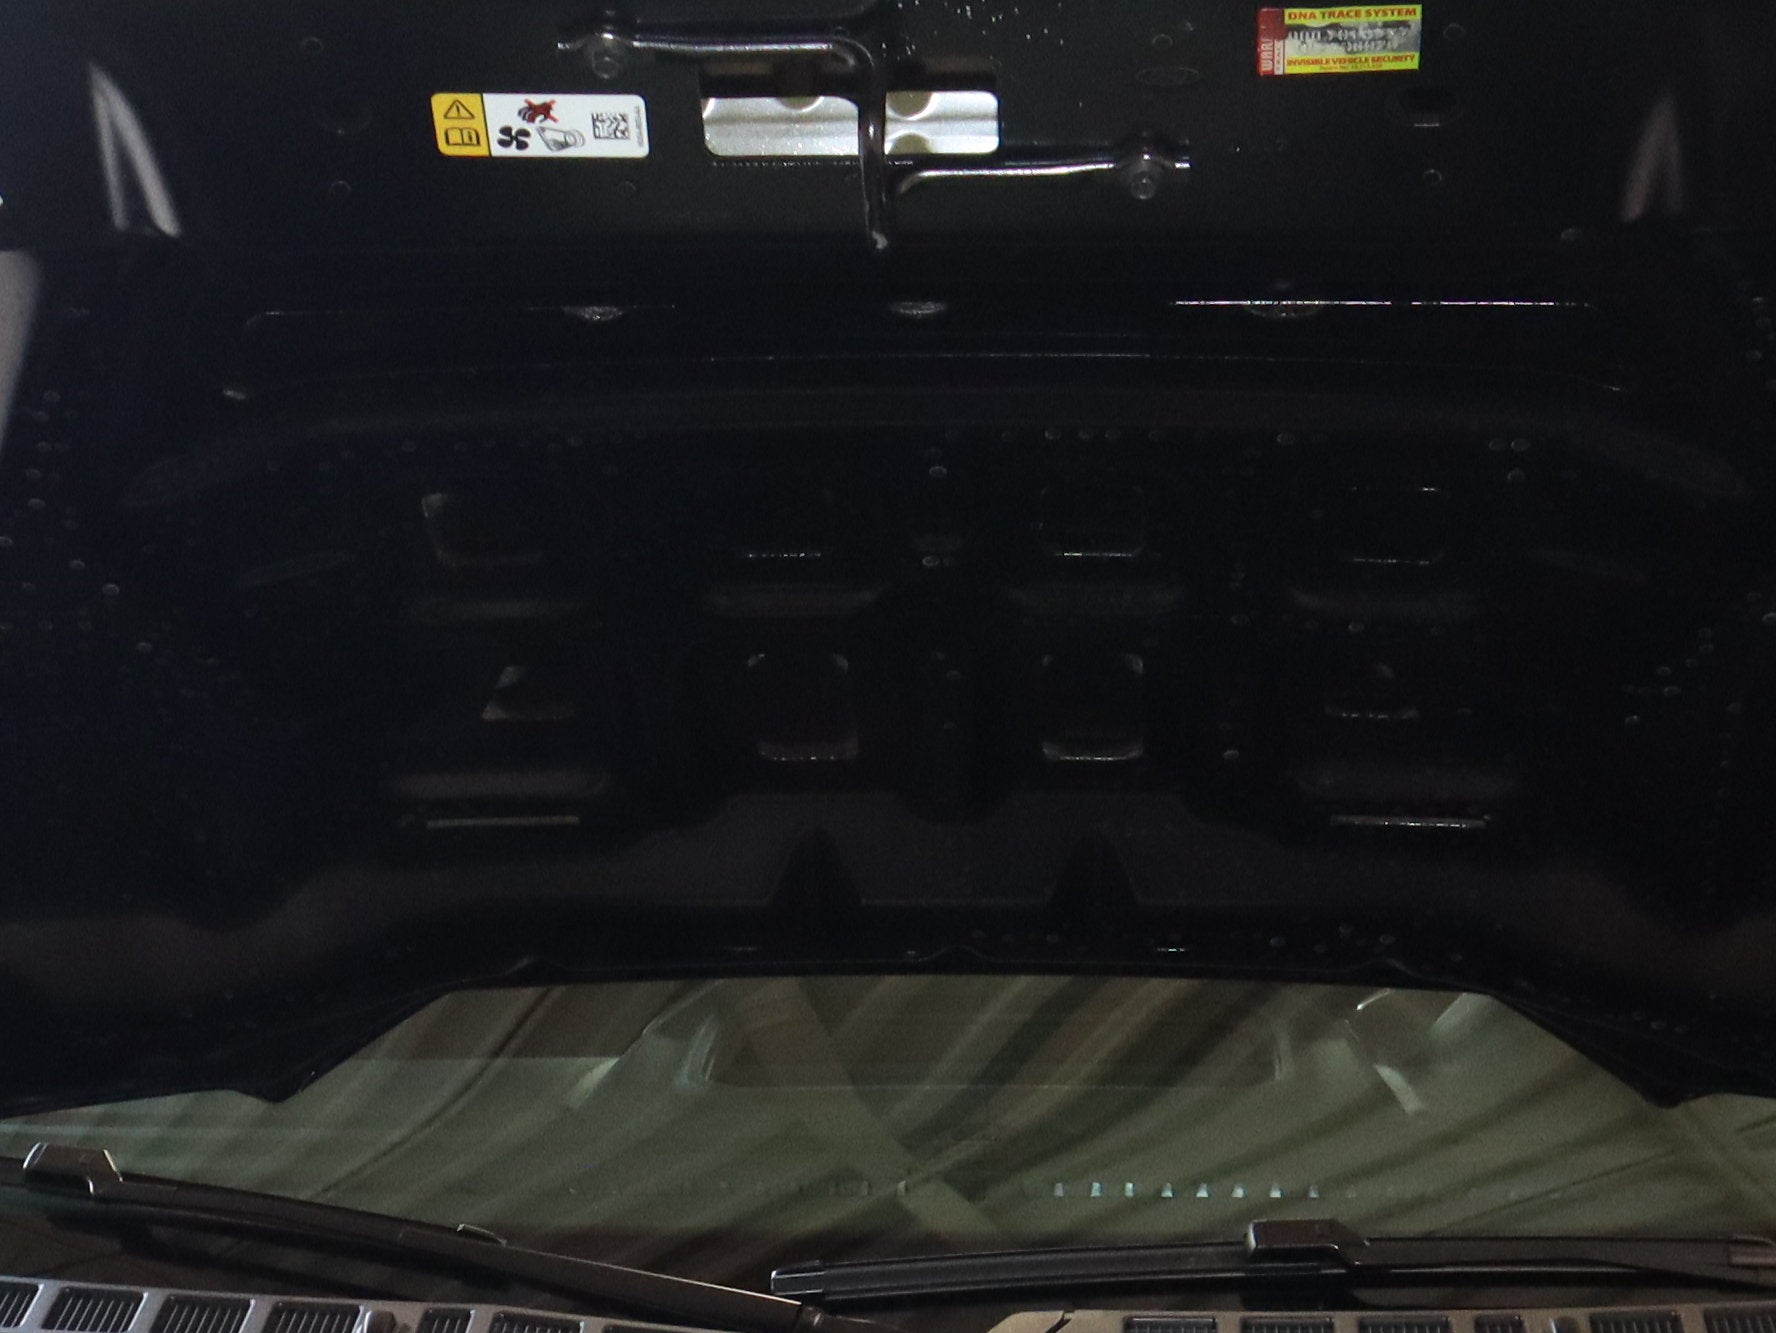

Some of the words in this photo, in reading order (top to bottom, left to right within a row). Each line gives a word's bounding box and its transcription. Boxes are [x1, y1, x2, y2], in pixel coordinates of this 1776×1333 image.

[1287, 11, 1317, 20] DNA
[1320, 9, 1364, 19] TRACE
[1366, 8, 1417, 18] SYSTEM
[1286, 57, 1330, 66] INVISIBLE
[1332, 56, 1370, 64] VEHICLE
[1371, 54, 1416, 63] SECURITY
